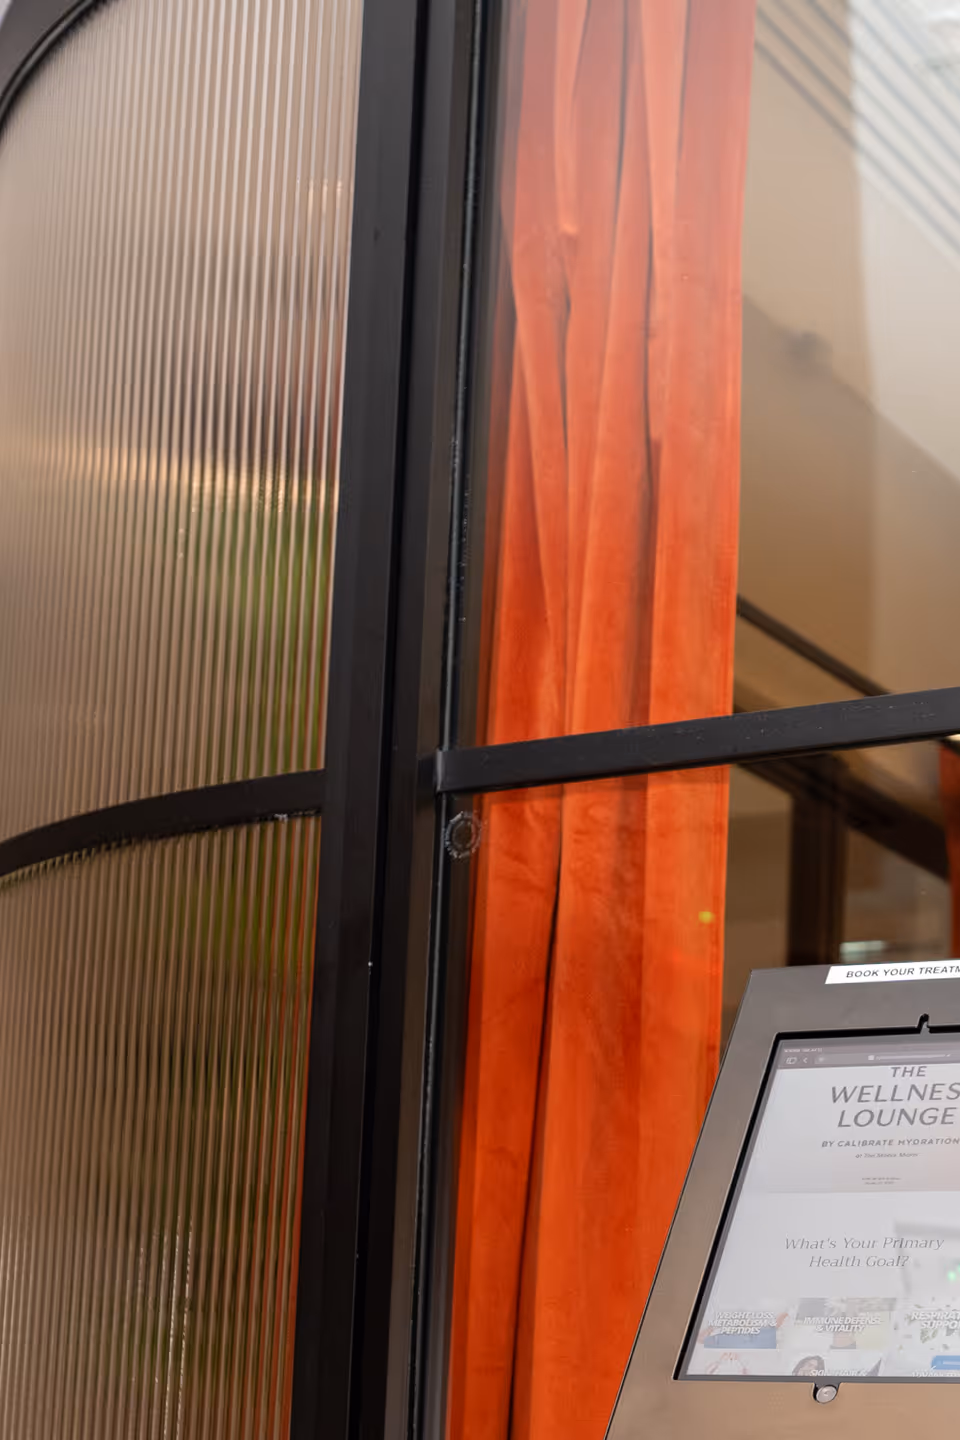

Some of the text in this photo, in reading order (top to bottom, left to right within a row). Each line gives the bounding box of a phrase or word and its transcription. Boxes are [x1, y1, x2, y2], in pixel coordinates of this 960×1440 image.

[846, 969, 879, 978] BOOK
[884, 968, 914, 976] YOUR
[890, 1066, 927, 1078] THE
[837, 1107, 957, 1128] LOUNGE
[821, 1137, 960, 1148] BY CALIBRATE HYDRATION
[785, 1237, 944, 1251] What's Your Primary
[808, 1255, 909, 1267] Health Goal?
[708, 1319, 767, 1327] METABOLISM
[804, 1316, 880, 1325] IMMUNE DEFENSE
[720, 1326, 760, 1334] PEPTIDES
